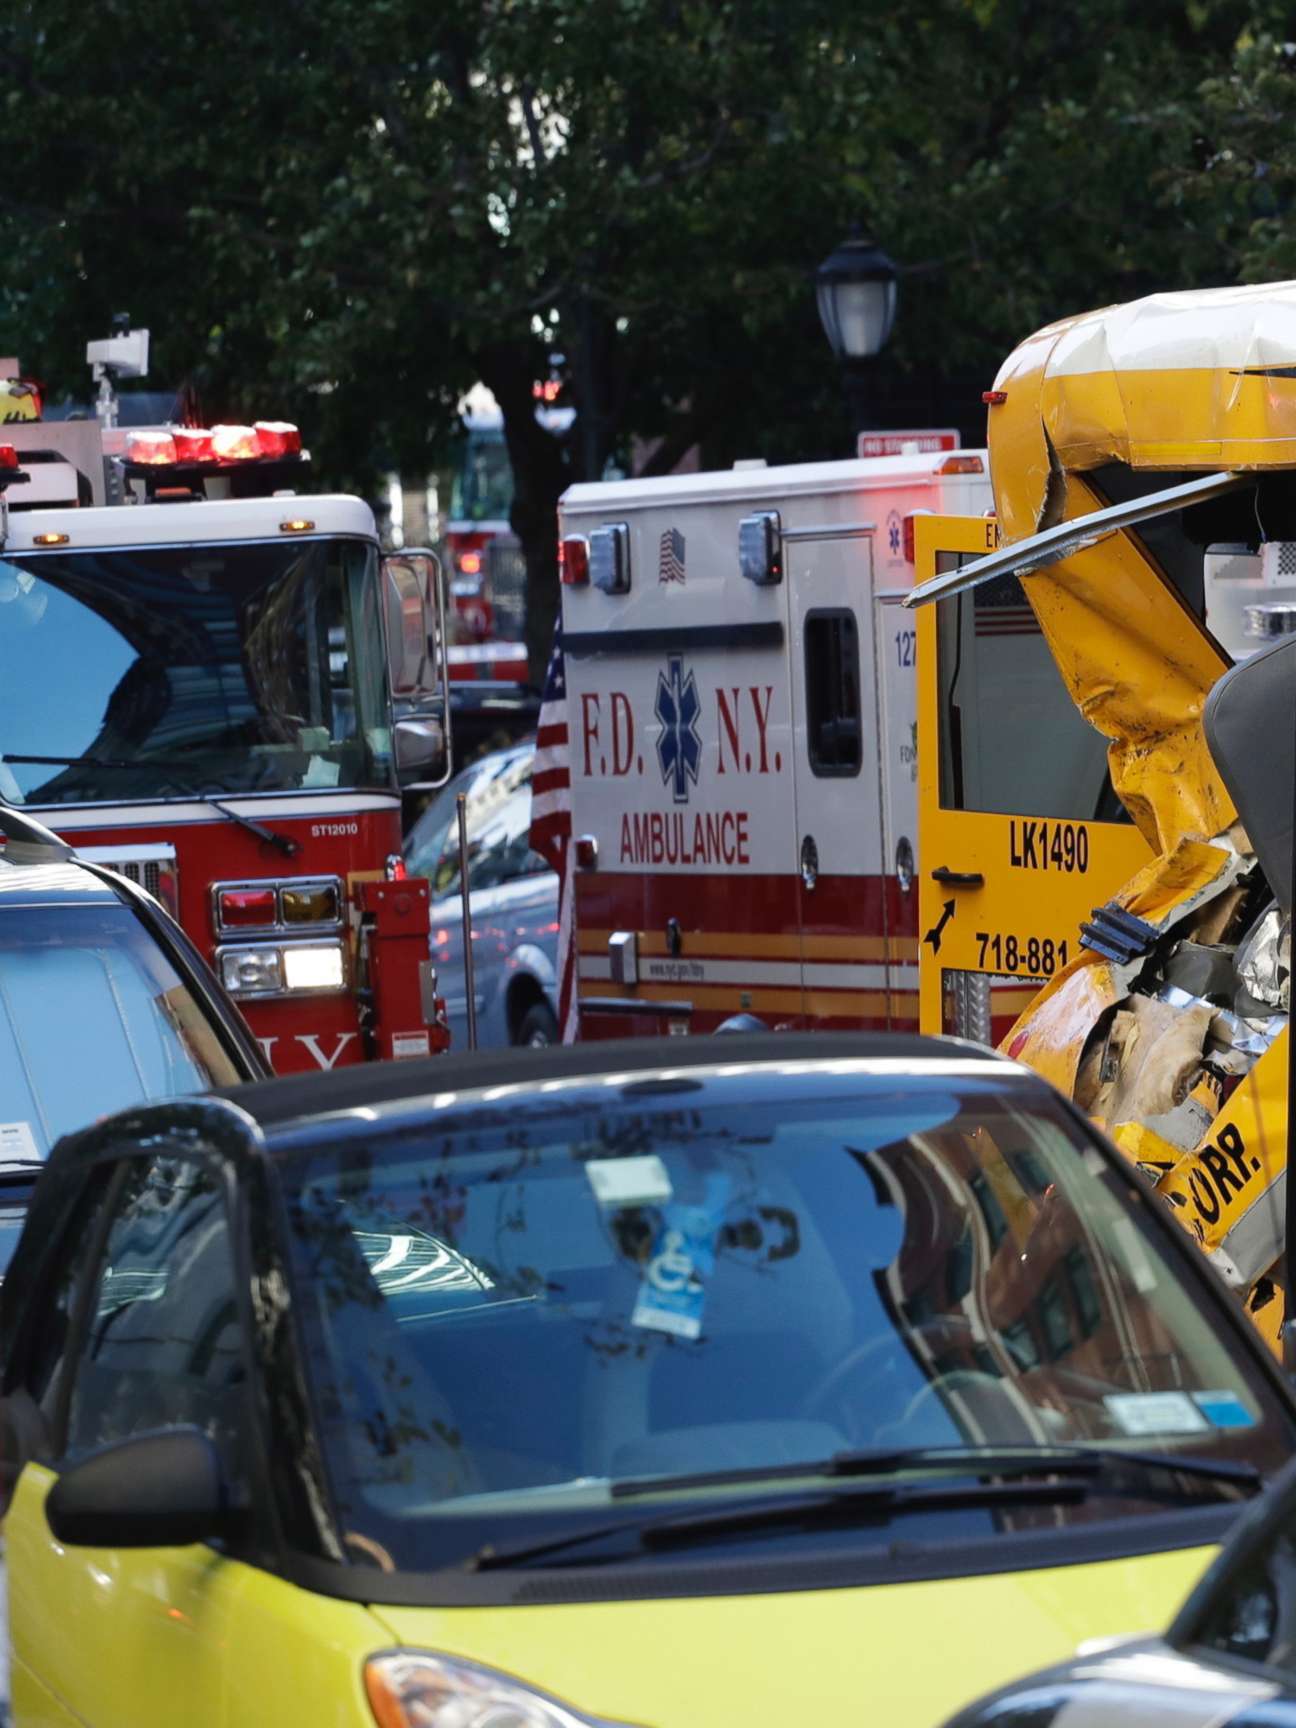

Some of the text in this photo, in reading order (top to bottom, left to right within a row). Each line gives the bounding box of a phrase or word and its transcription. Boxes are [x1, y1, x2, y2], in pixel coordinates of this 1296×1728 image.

[580, 686, 782, 777] F.D. N.Y.
[311, 823, 358, 839] ST12010
[619, 811, 750, 865] AMBULANCE
[1009, 820, 1089, 874] LK1490
[975, 932, 1069, 976] 718-881
